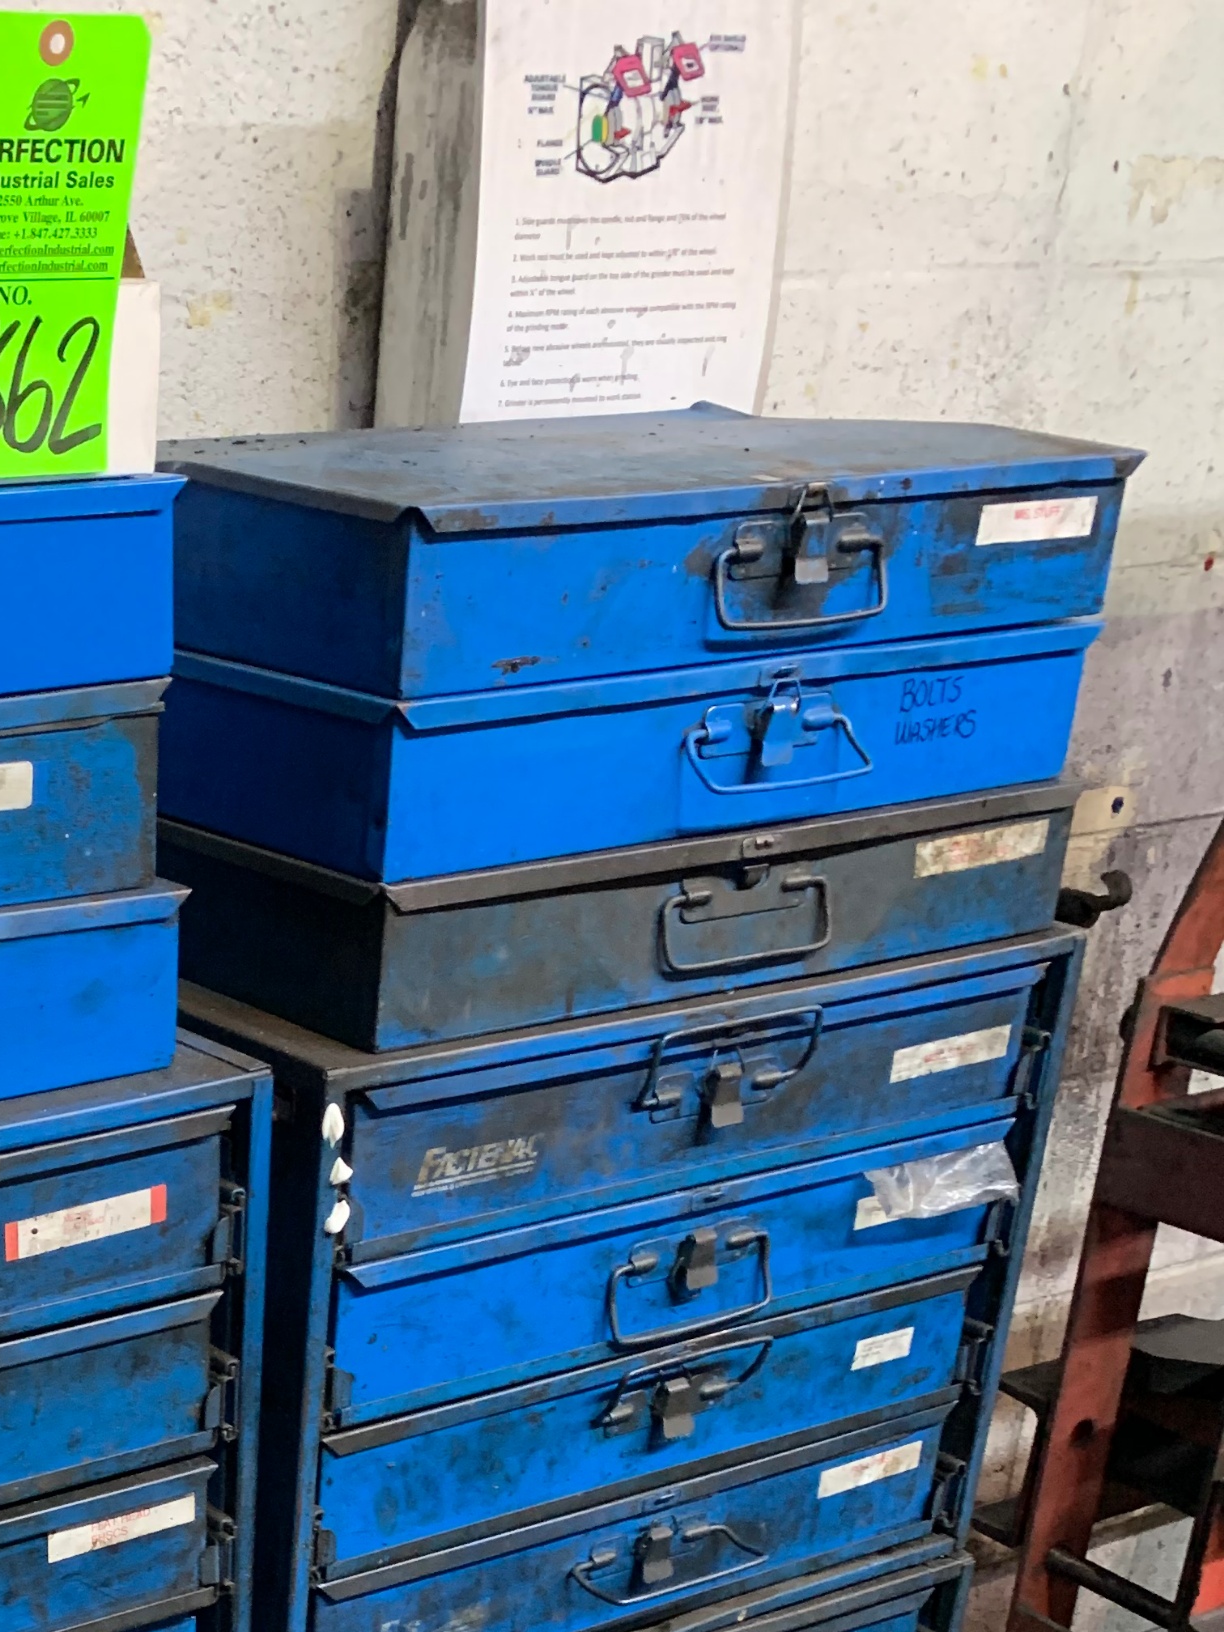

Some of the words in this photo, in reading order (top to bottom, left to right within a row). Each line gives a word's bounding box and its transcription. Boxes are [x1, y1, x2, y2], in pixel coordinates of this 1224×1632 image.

[65, 170, 115, 189] Sales
[25, 194, 59, 207] Arthur
[61, 194, 84, 207] Ave.
[22, 211, 62, 226] Village,
[899, 676, 965, 714] BOLTS
[893, 709, 978, 746] WASHERS
